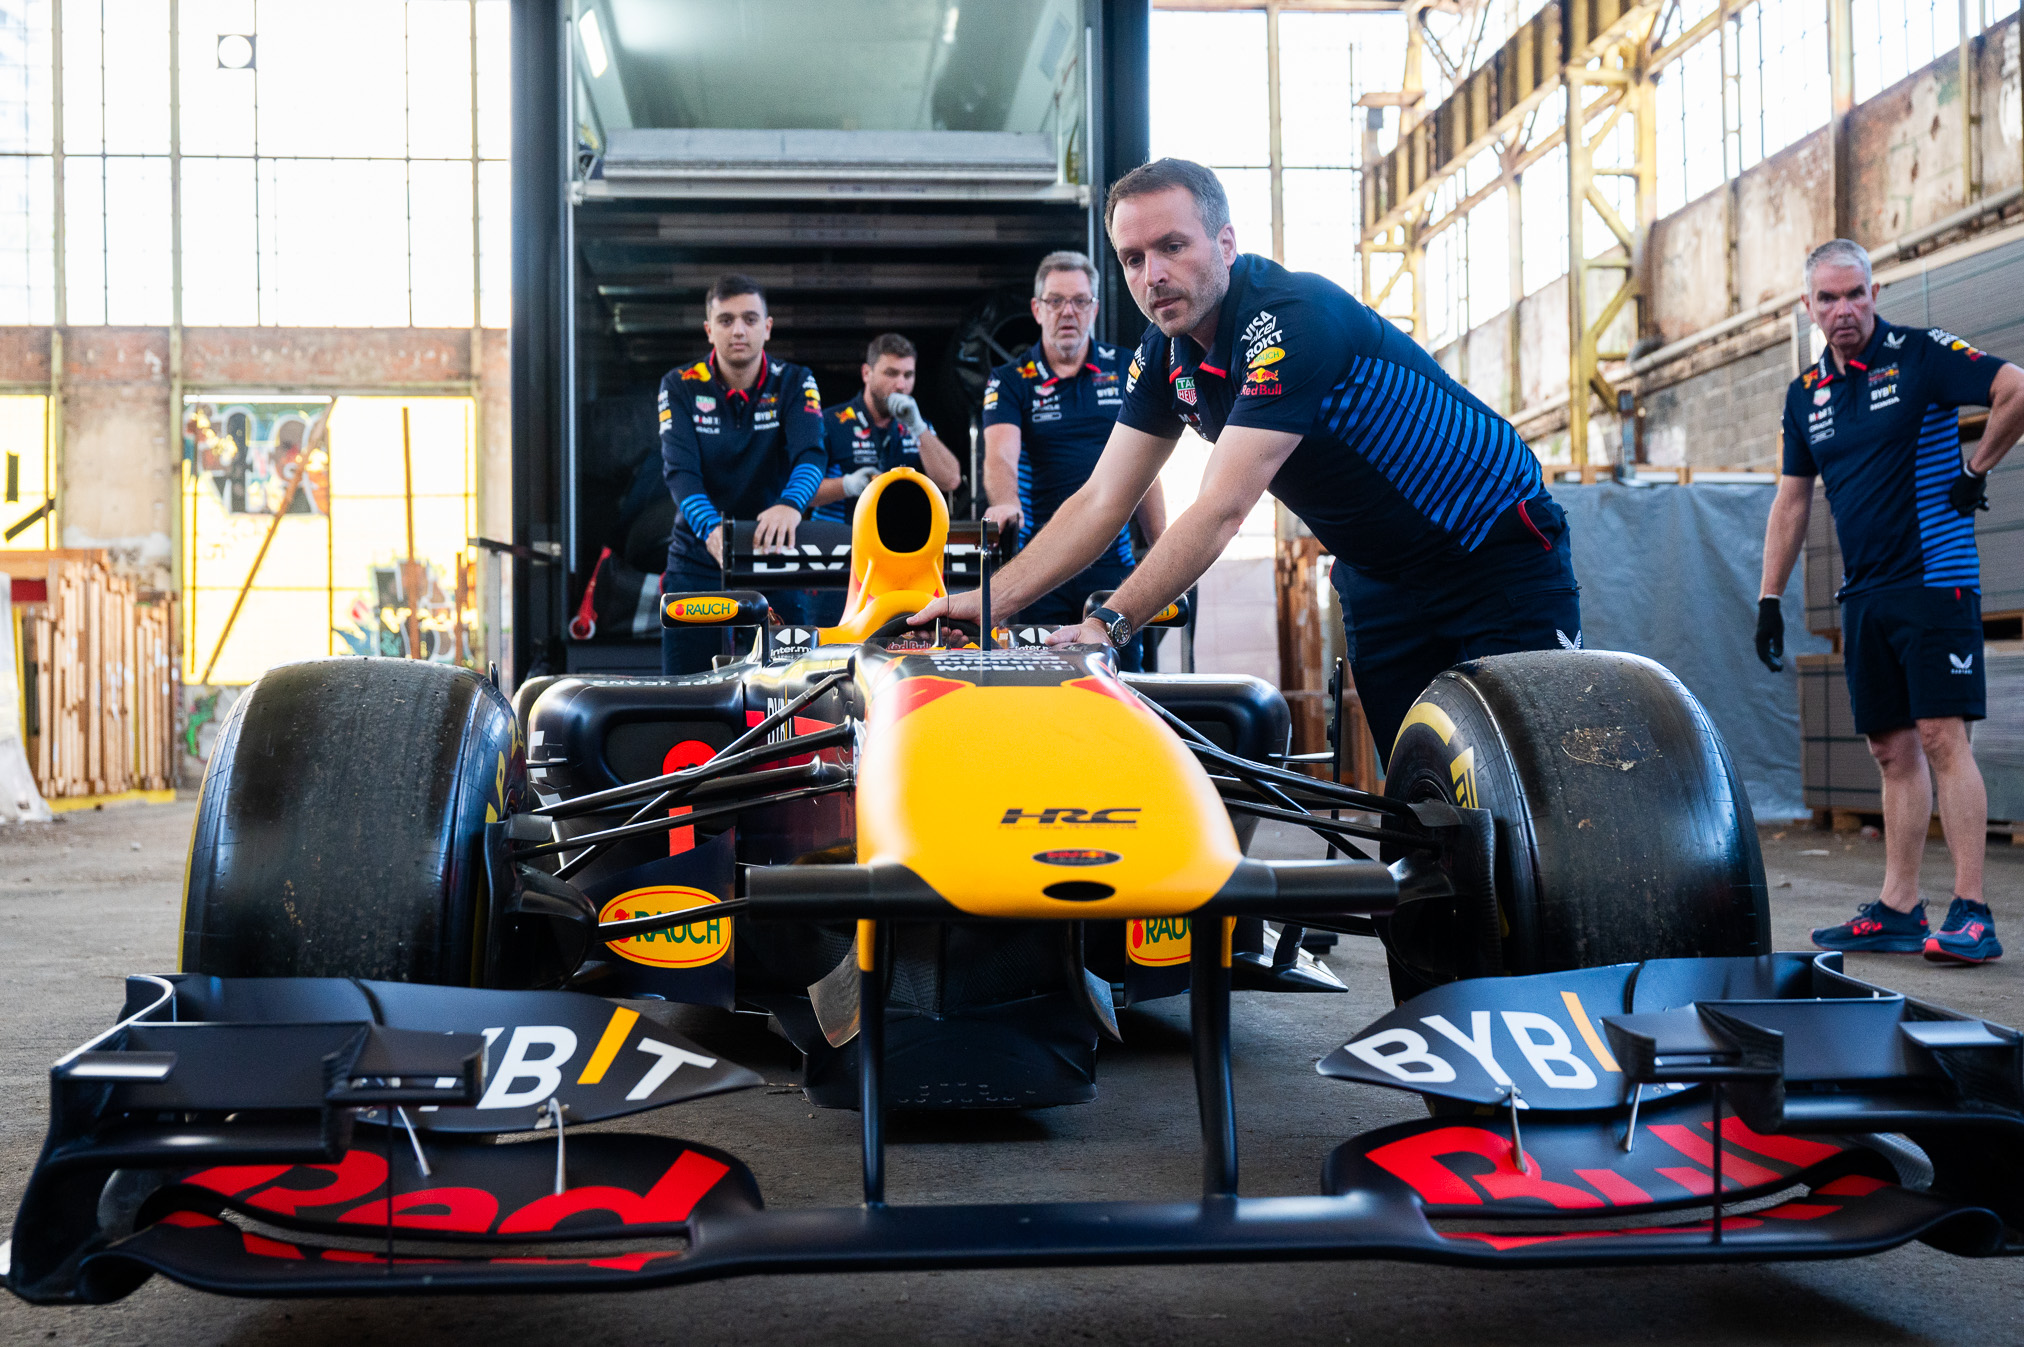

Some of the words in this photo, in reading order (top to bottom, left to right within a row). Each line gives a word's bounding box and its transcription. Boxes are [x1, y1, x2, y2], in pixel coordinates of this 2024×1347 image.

[1240, 310, 1274, 341] VISA
[1249, 316, 1277, 347] lcel
[1245, 329, 1283, 363] ROKT
[1178, 390, 1197, 403] HEUE
[1240, 383, 1259, 396] Red
[1260, 383, 1282, 395] Bull
[1870, 383, 1897, 401] BYBIT
[753, 545, 981, 572] BYT
[686, 603, 731, 616] RAUCH
[770, 646, 811, 657] inter.m
[591, 679, 671, 687] JEANS
[1000, 808, 1142, 824] HRC
[634, 911, 721, 945] RAUCH
[1145, 917, 1191, 945] RAU
[418, 1006, 717, 1112] BIT
[1344, 991, 1625, 1109] BYBI
[158, 1150, 730, 1272] Red
